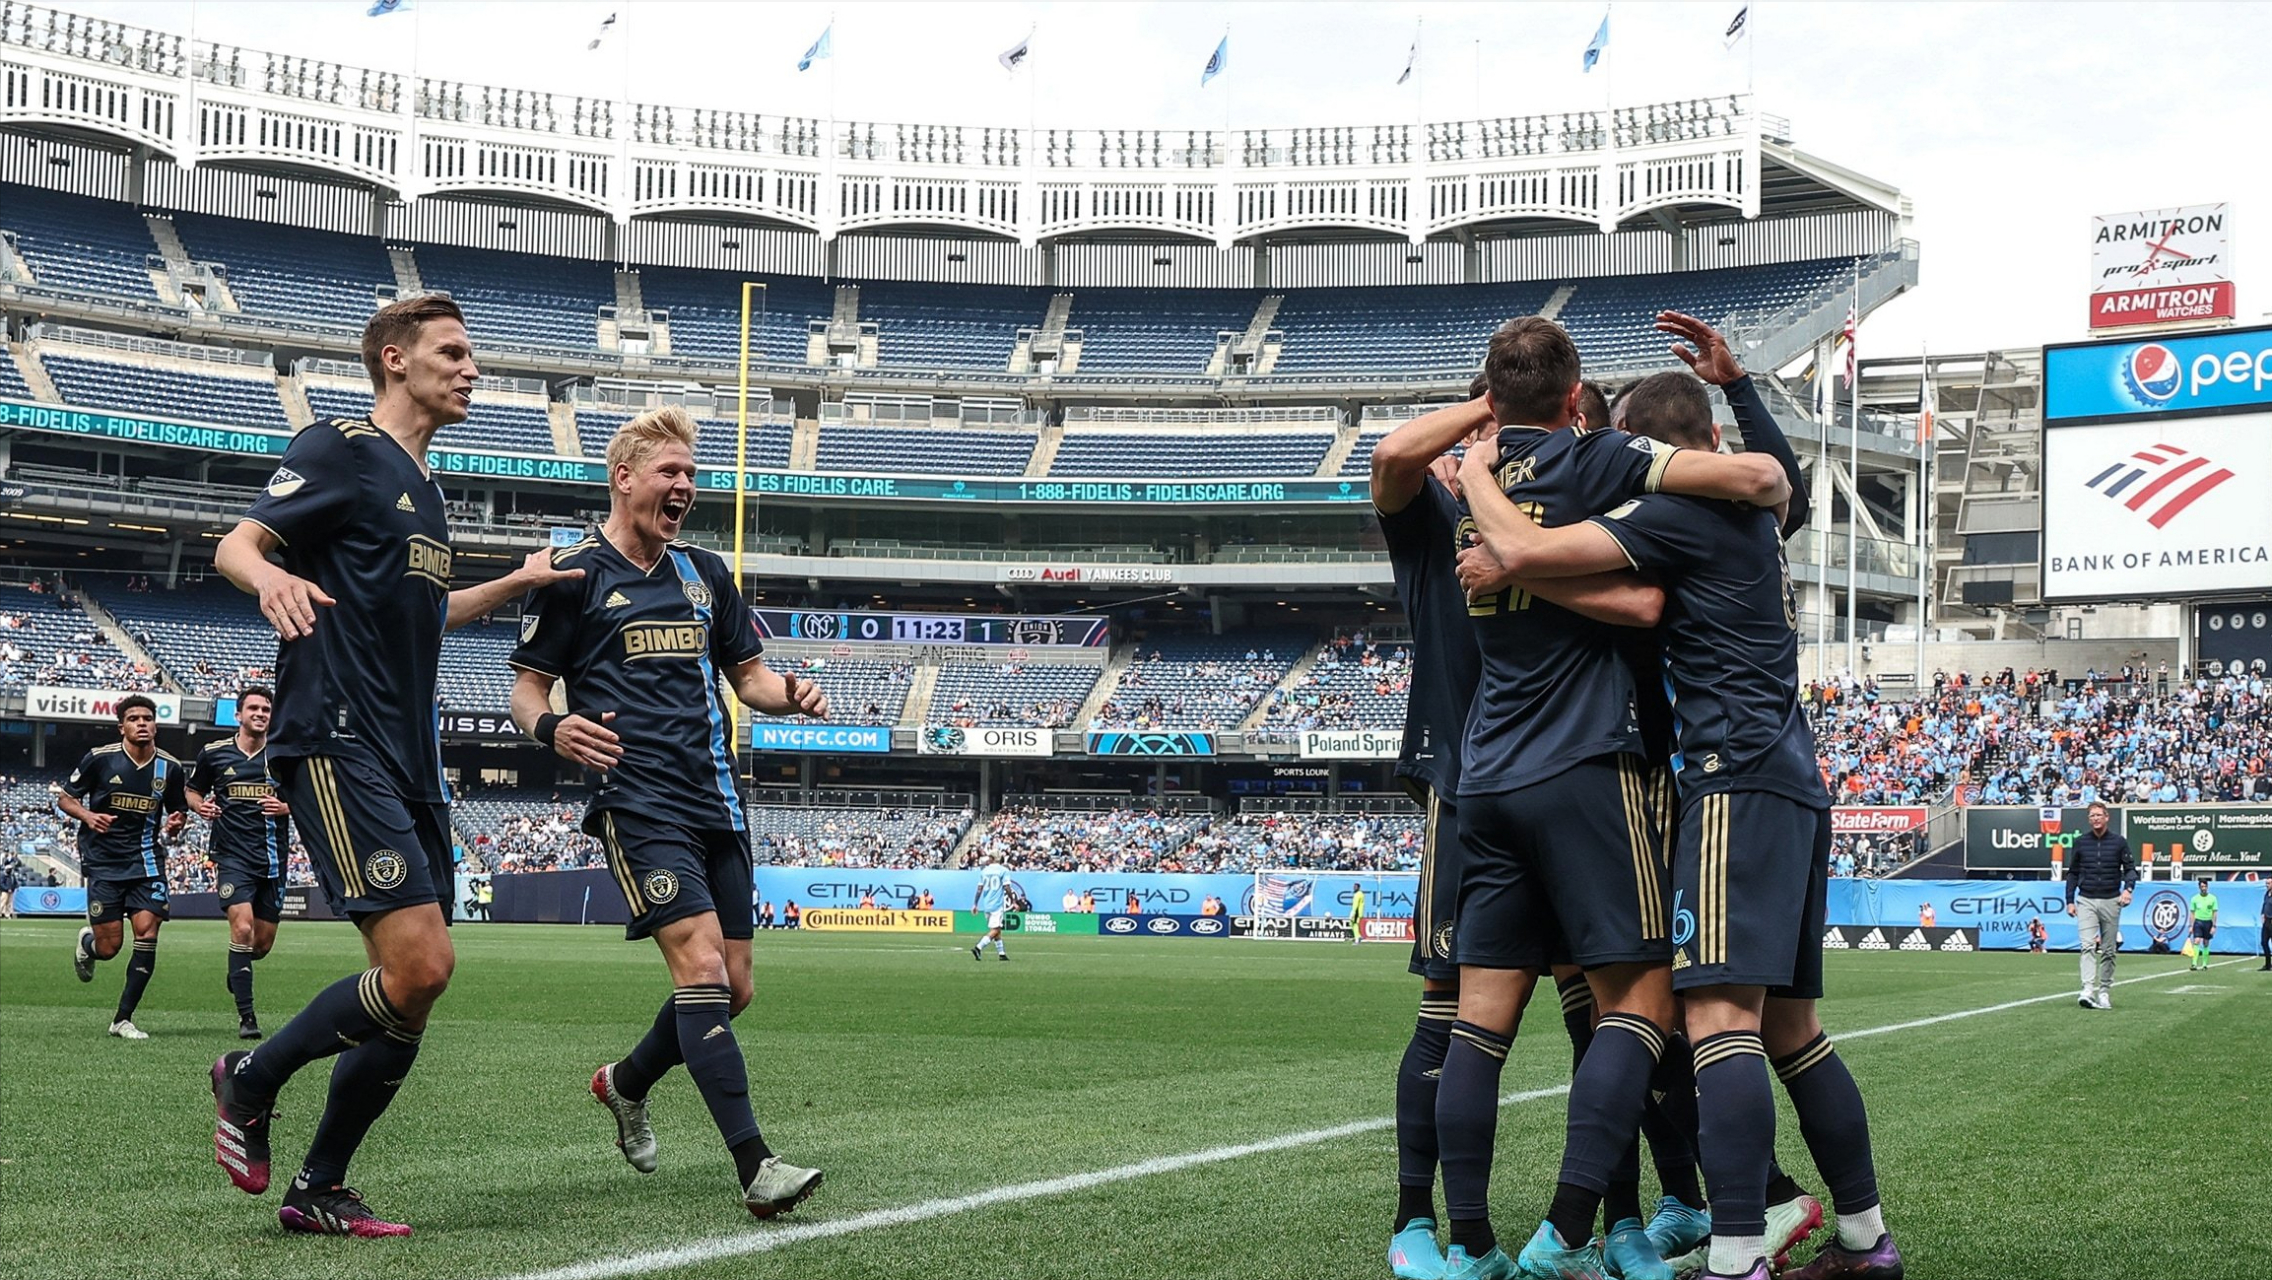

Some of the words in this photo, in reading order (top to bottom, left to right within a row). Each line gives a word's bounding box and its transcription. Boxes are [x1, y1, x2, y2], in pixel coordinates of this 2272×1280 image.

[2095, 214, 2223, 243] ARMITRON
[2101, 287, 2216, 313] ARMITRON
[2156, 304, 2213, 318] WATCHES
[107, 418, 268, 453] FIDELISCARE.ORG
[447, 453, 464, 471] IS
[469, 455, 534, 476] FIDELIS
[538, 461, 589, 481] CARE.
[1, 487, 24, 496] 2009
[758, 475, 779, 491] ES
[784, 476, 846, 494] FIDELIS
[850, 478, 899, 496] CARE.
[1019, 484, 1132, 500] 1-888-FIDELIS
[1146, 484, 1284, 501] FIDELISCARE.ORG
[2051, 554, 2115, 572] BANK
[2123, 552, 2151, 569] OF
[2159, 546, 2269, 567] AMERICA
[1041, 567, 1081, 581] Audi
[1086, 568, 1140, 582] YANKEES
[1142, 568, 1173, 582] CLUB
[861, 618, 879, 639] 0
[897, 620, 962, 640] 11:23
[980, 622, 991, 642] 1
[624, 627, 706, 654] BIMBO
[910, 645, 986, 661] LANDING
[37, 694, 87, 714] visit
[439, 717, 524, 734] ISSA
[763, 729, 877, 747] NYCFC.COM
[984, 731, 1037, 746] ORIS
[1307, 733, 1360, 754] Poland
[1273, 768, 1304, 776] SPORTS
[228, 786, 274, 798] BIMBO
[111, 795, 157, 810] BIMBO
[2133, 815, 2182, 824] Workmen's
[2184, 815, 2211, 824] Circle
[2219, 814, 2272, 825] Morningside
[1992, 829, 2042, 848] Uber
[807, 883, 916, 899] ETIHAD
[1089, 887, 1191, 904] ETIHAD
[1951, 897, 2065, 914] ETIHAD
[806, 910, 895, 929] Continental
[913, 916, 948, 927] TIRE
[1977, 921, 2031, 932] AIRWAY
[1310, 930, 1345, 938] AIRWAYS
[1858, 942, 1891, 950] adidas
[1899, 943, 1932, 951] adidas
[1940, 943, 1973, 952] adidas
